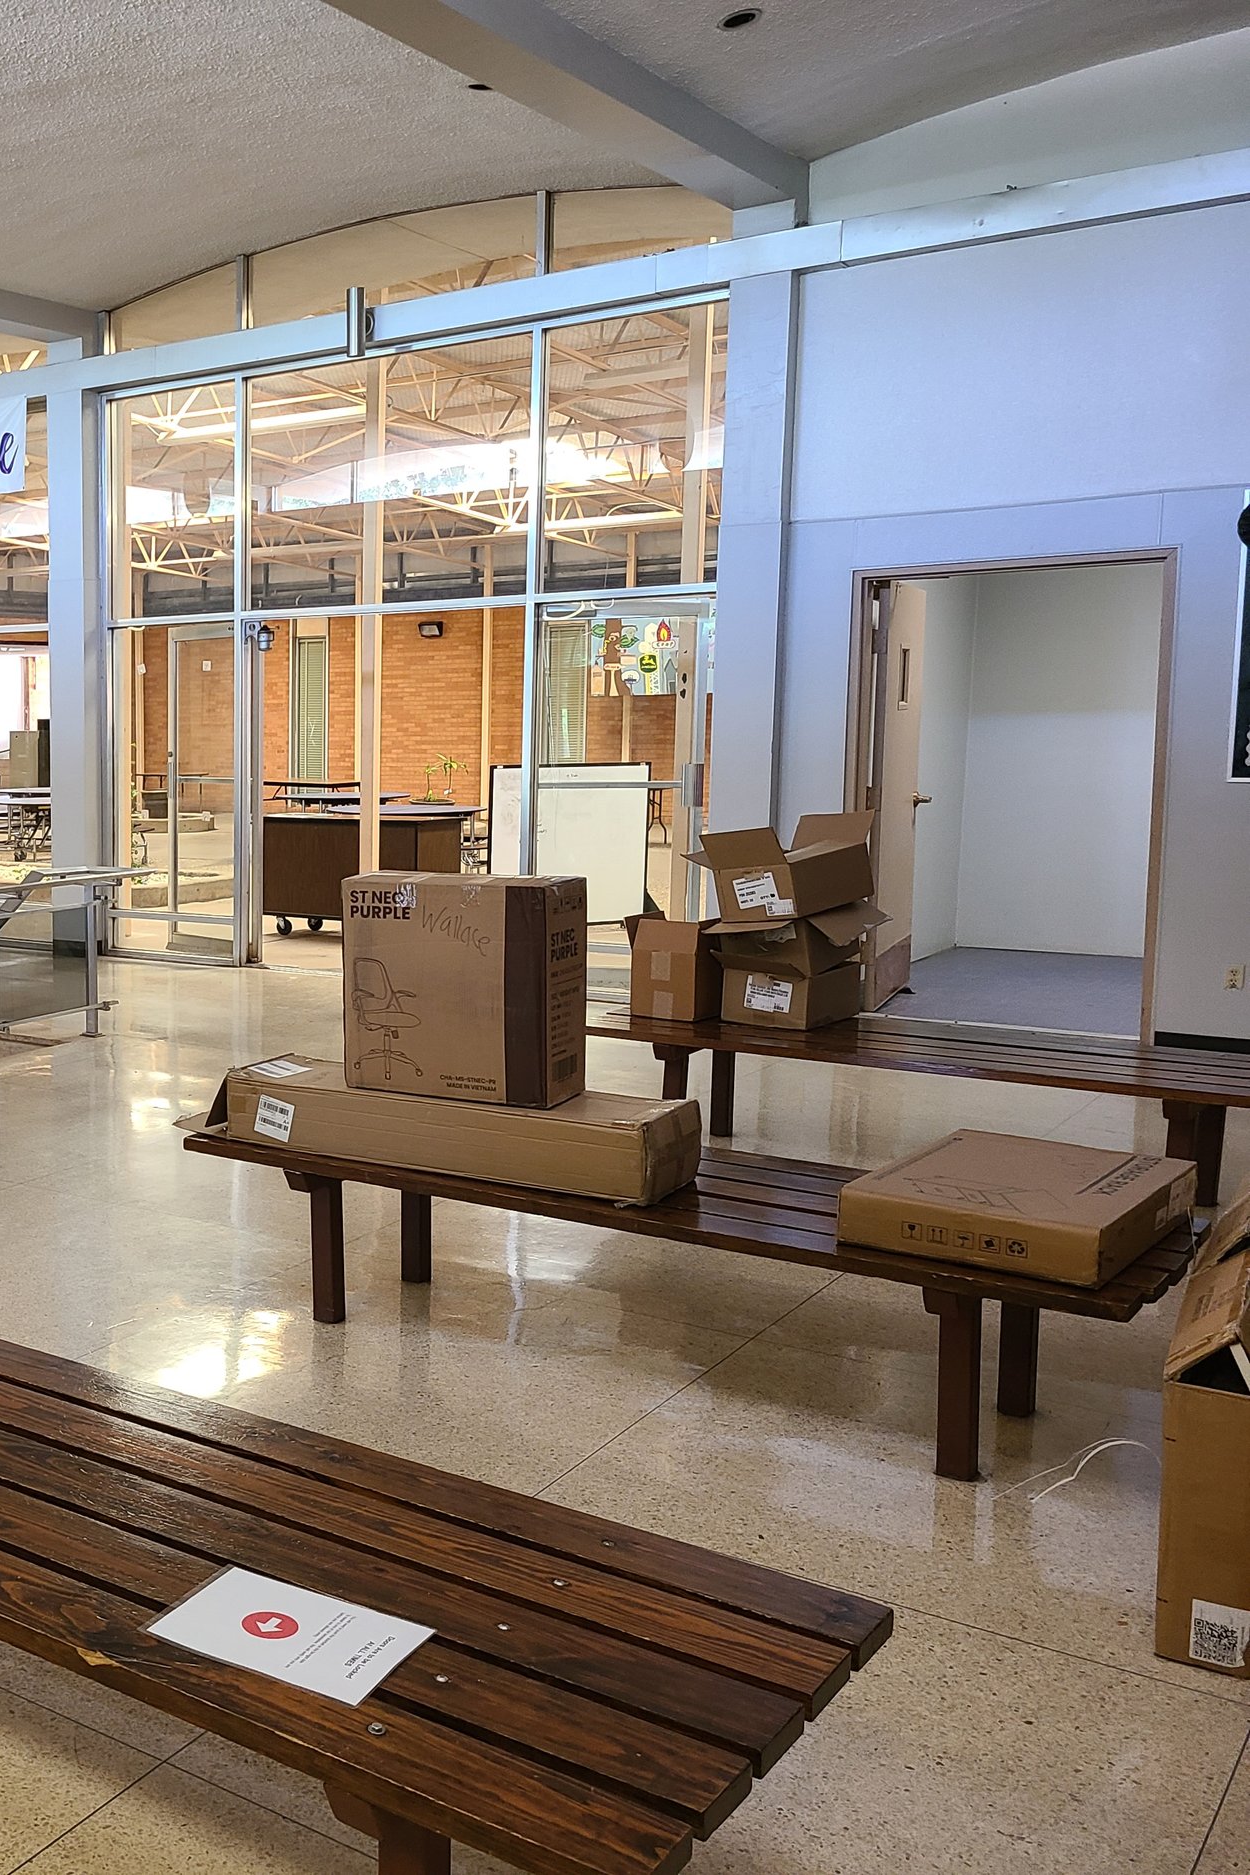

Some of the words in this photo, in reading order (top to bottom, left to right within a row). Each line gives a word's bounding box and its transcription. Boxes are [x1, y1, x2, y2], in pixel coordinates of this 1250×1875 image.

[350, 890, 368, 904] ST
[350, 906, 410, 920] PURPLE
[422, 904, 491, 957] Wallace
[551, 931, 560, 947] ST
[560, 928, 575, 944] NEC
[551, 942, 578, 962] PURPLE
[470, 1084, 497, 1092] VIETNAM
[380, 1635, 396, 1649] Doors
[357, 1644, 369, 1655] ALL
[372, 1645, 383, 1655] Are
[344, 1652, 361, 1667] TIMES
[361, 1657, 369, 1665] be
[345, 1663, 364, 1679] Locked
